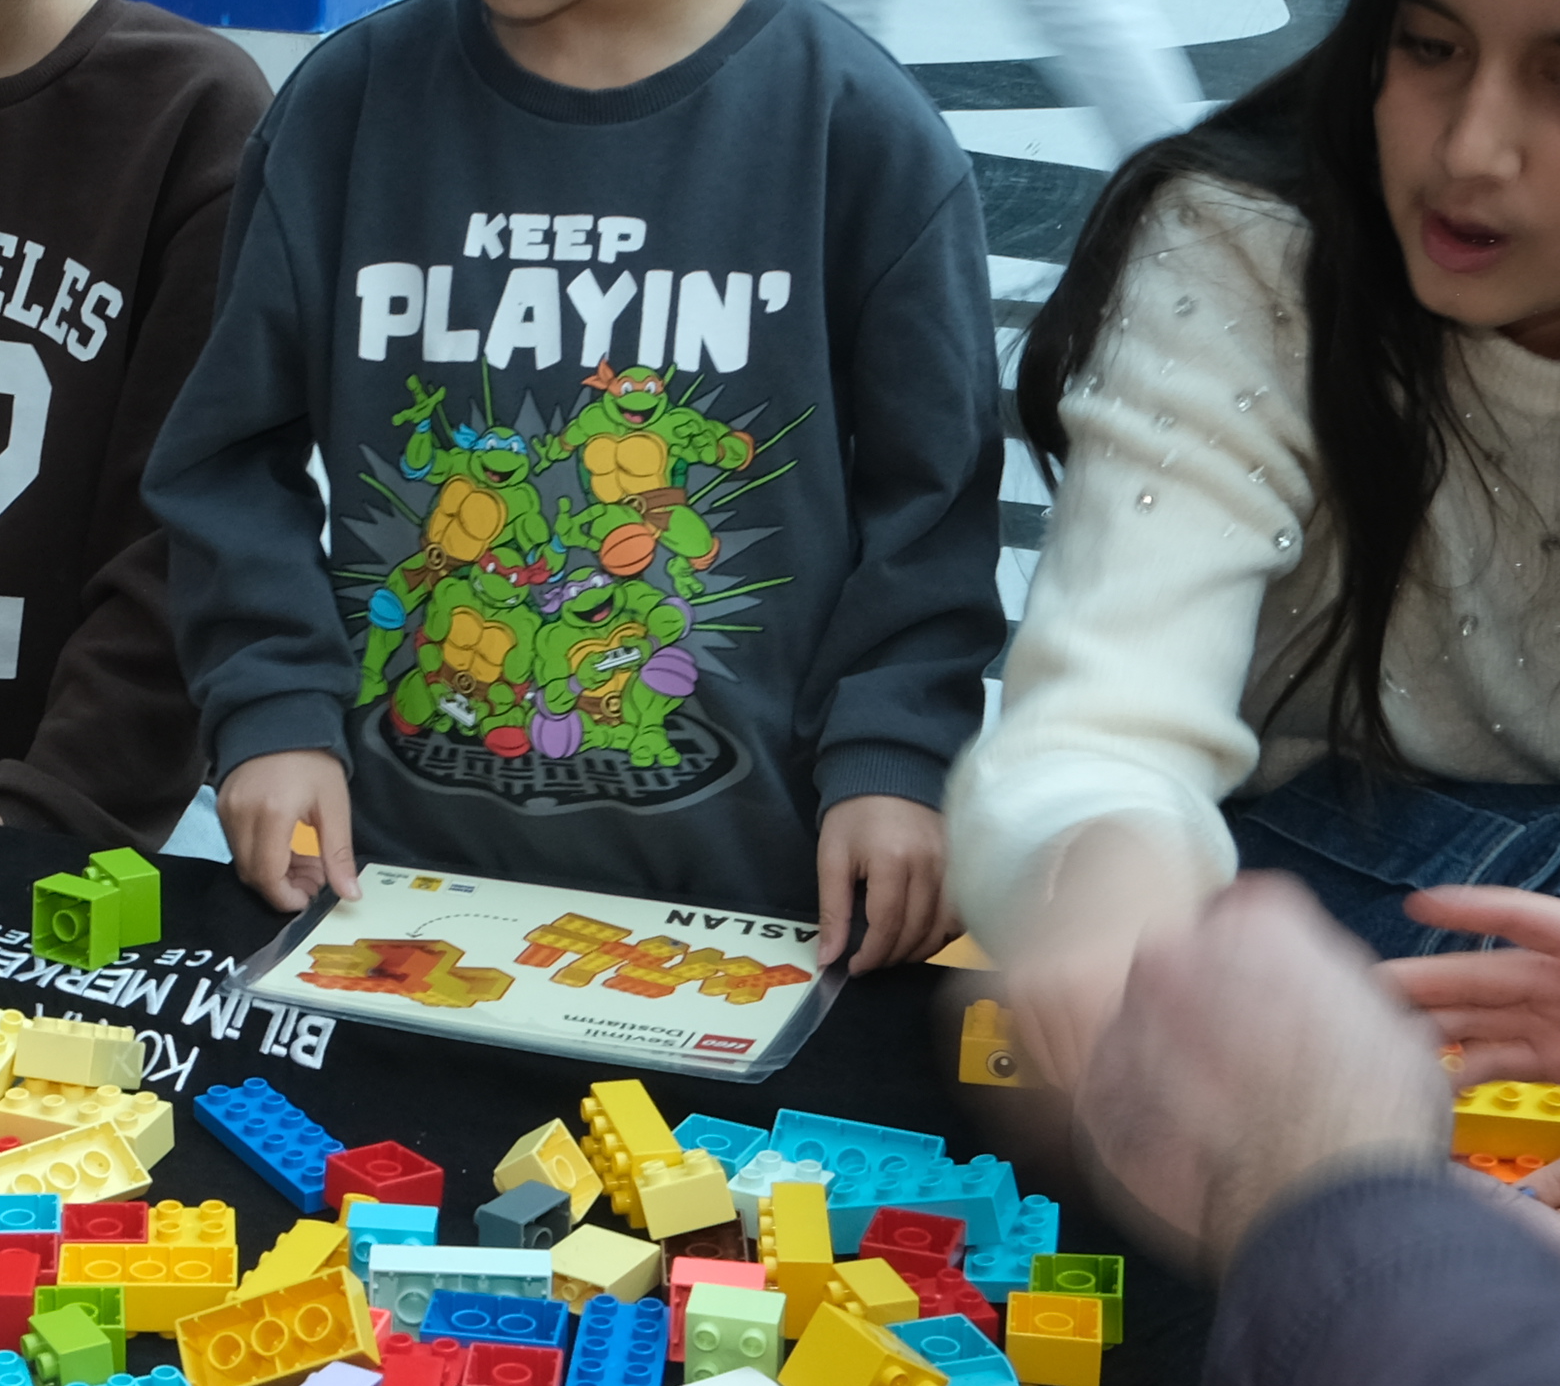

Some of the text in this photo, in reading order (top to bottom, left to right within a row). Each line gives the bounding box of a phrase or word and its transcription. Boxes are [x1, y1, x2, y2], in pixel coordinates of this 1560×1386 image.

[463, 212, 647, 264] KEEP
[355, 261, 792, 373] PLAYIN'
[665, 908, 821, 944] ASLAN
